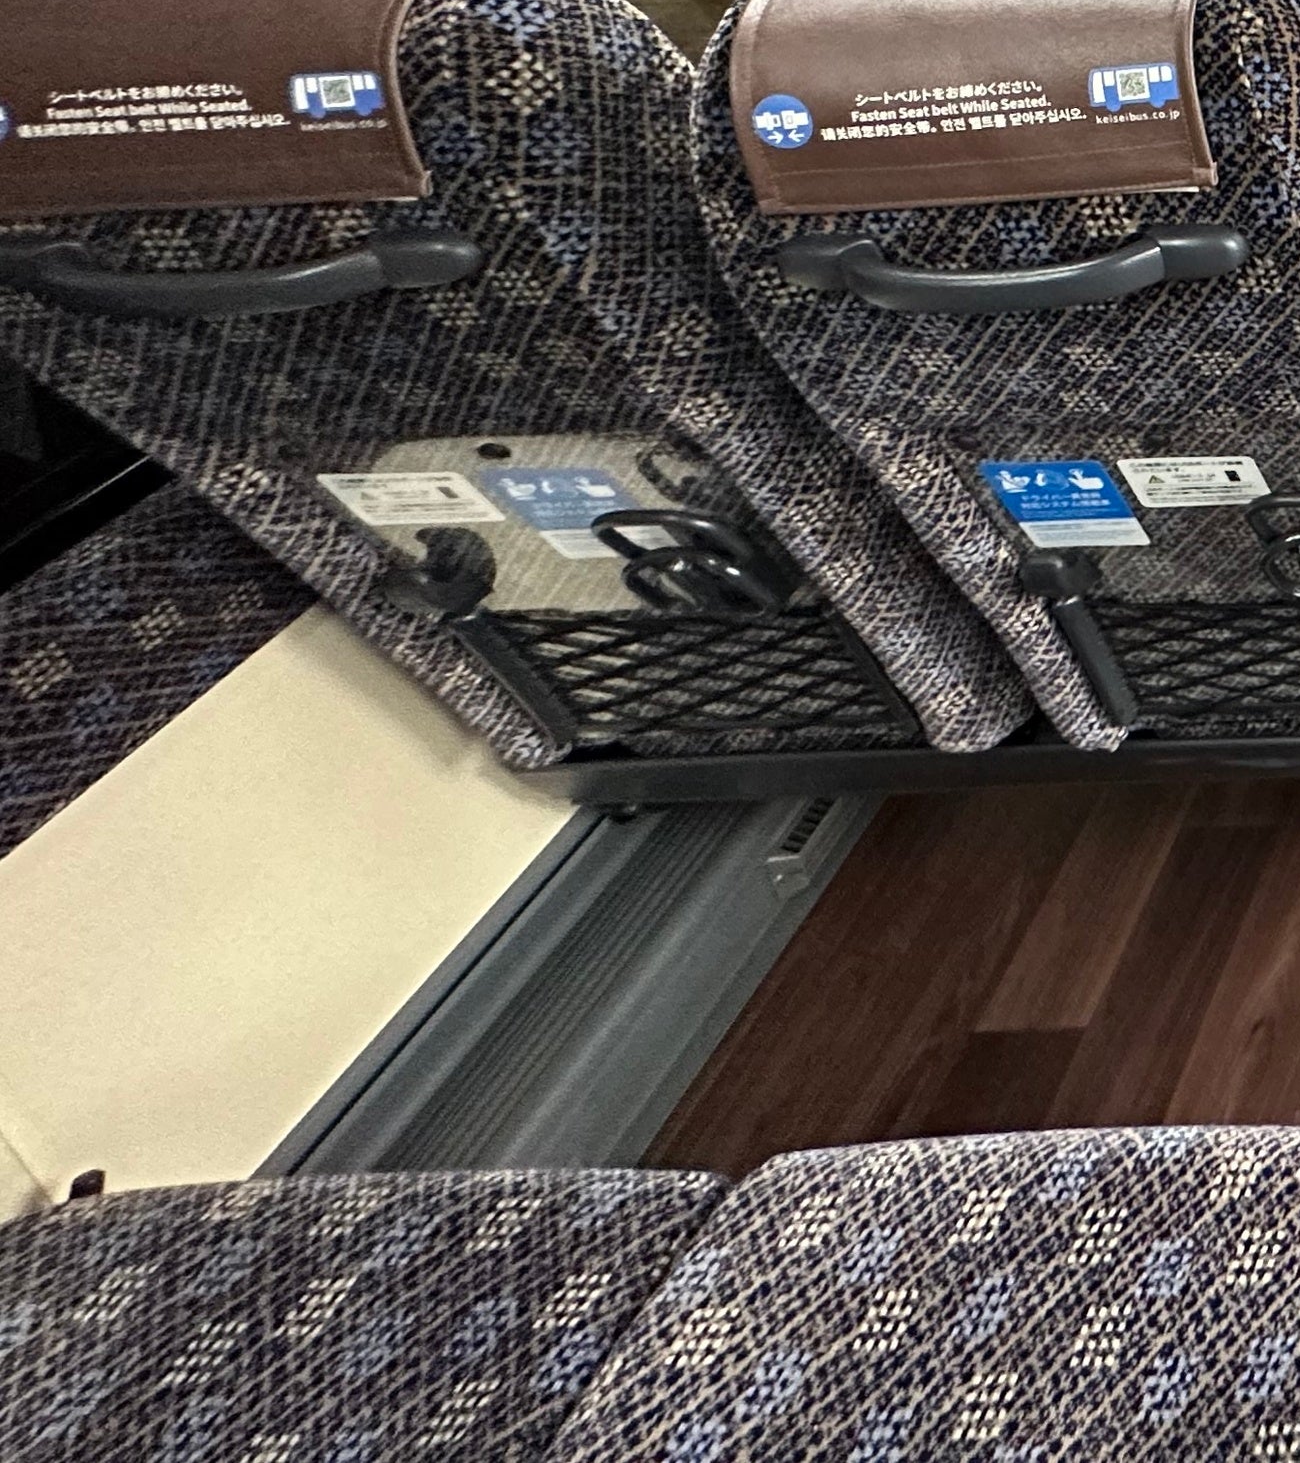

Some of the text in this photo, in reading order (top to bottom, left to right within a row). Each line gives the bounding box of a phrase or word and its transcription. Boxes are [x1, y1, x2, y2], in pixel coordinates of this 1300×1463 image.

[855, 80, 1043, 107] シートベルトをお締めください。
[851, 94, 1052, 123] Fasten Seat belt While Seated.
[1095, 110, 1181, 125] keiseibus.co.jp
